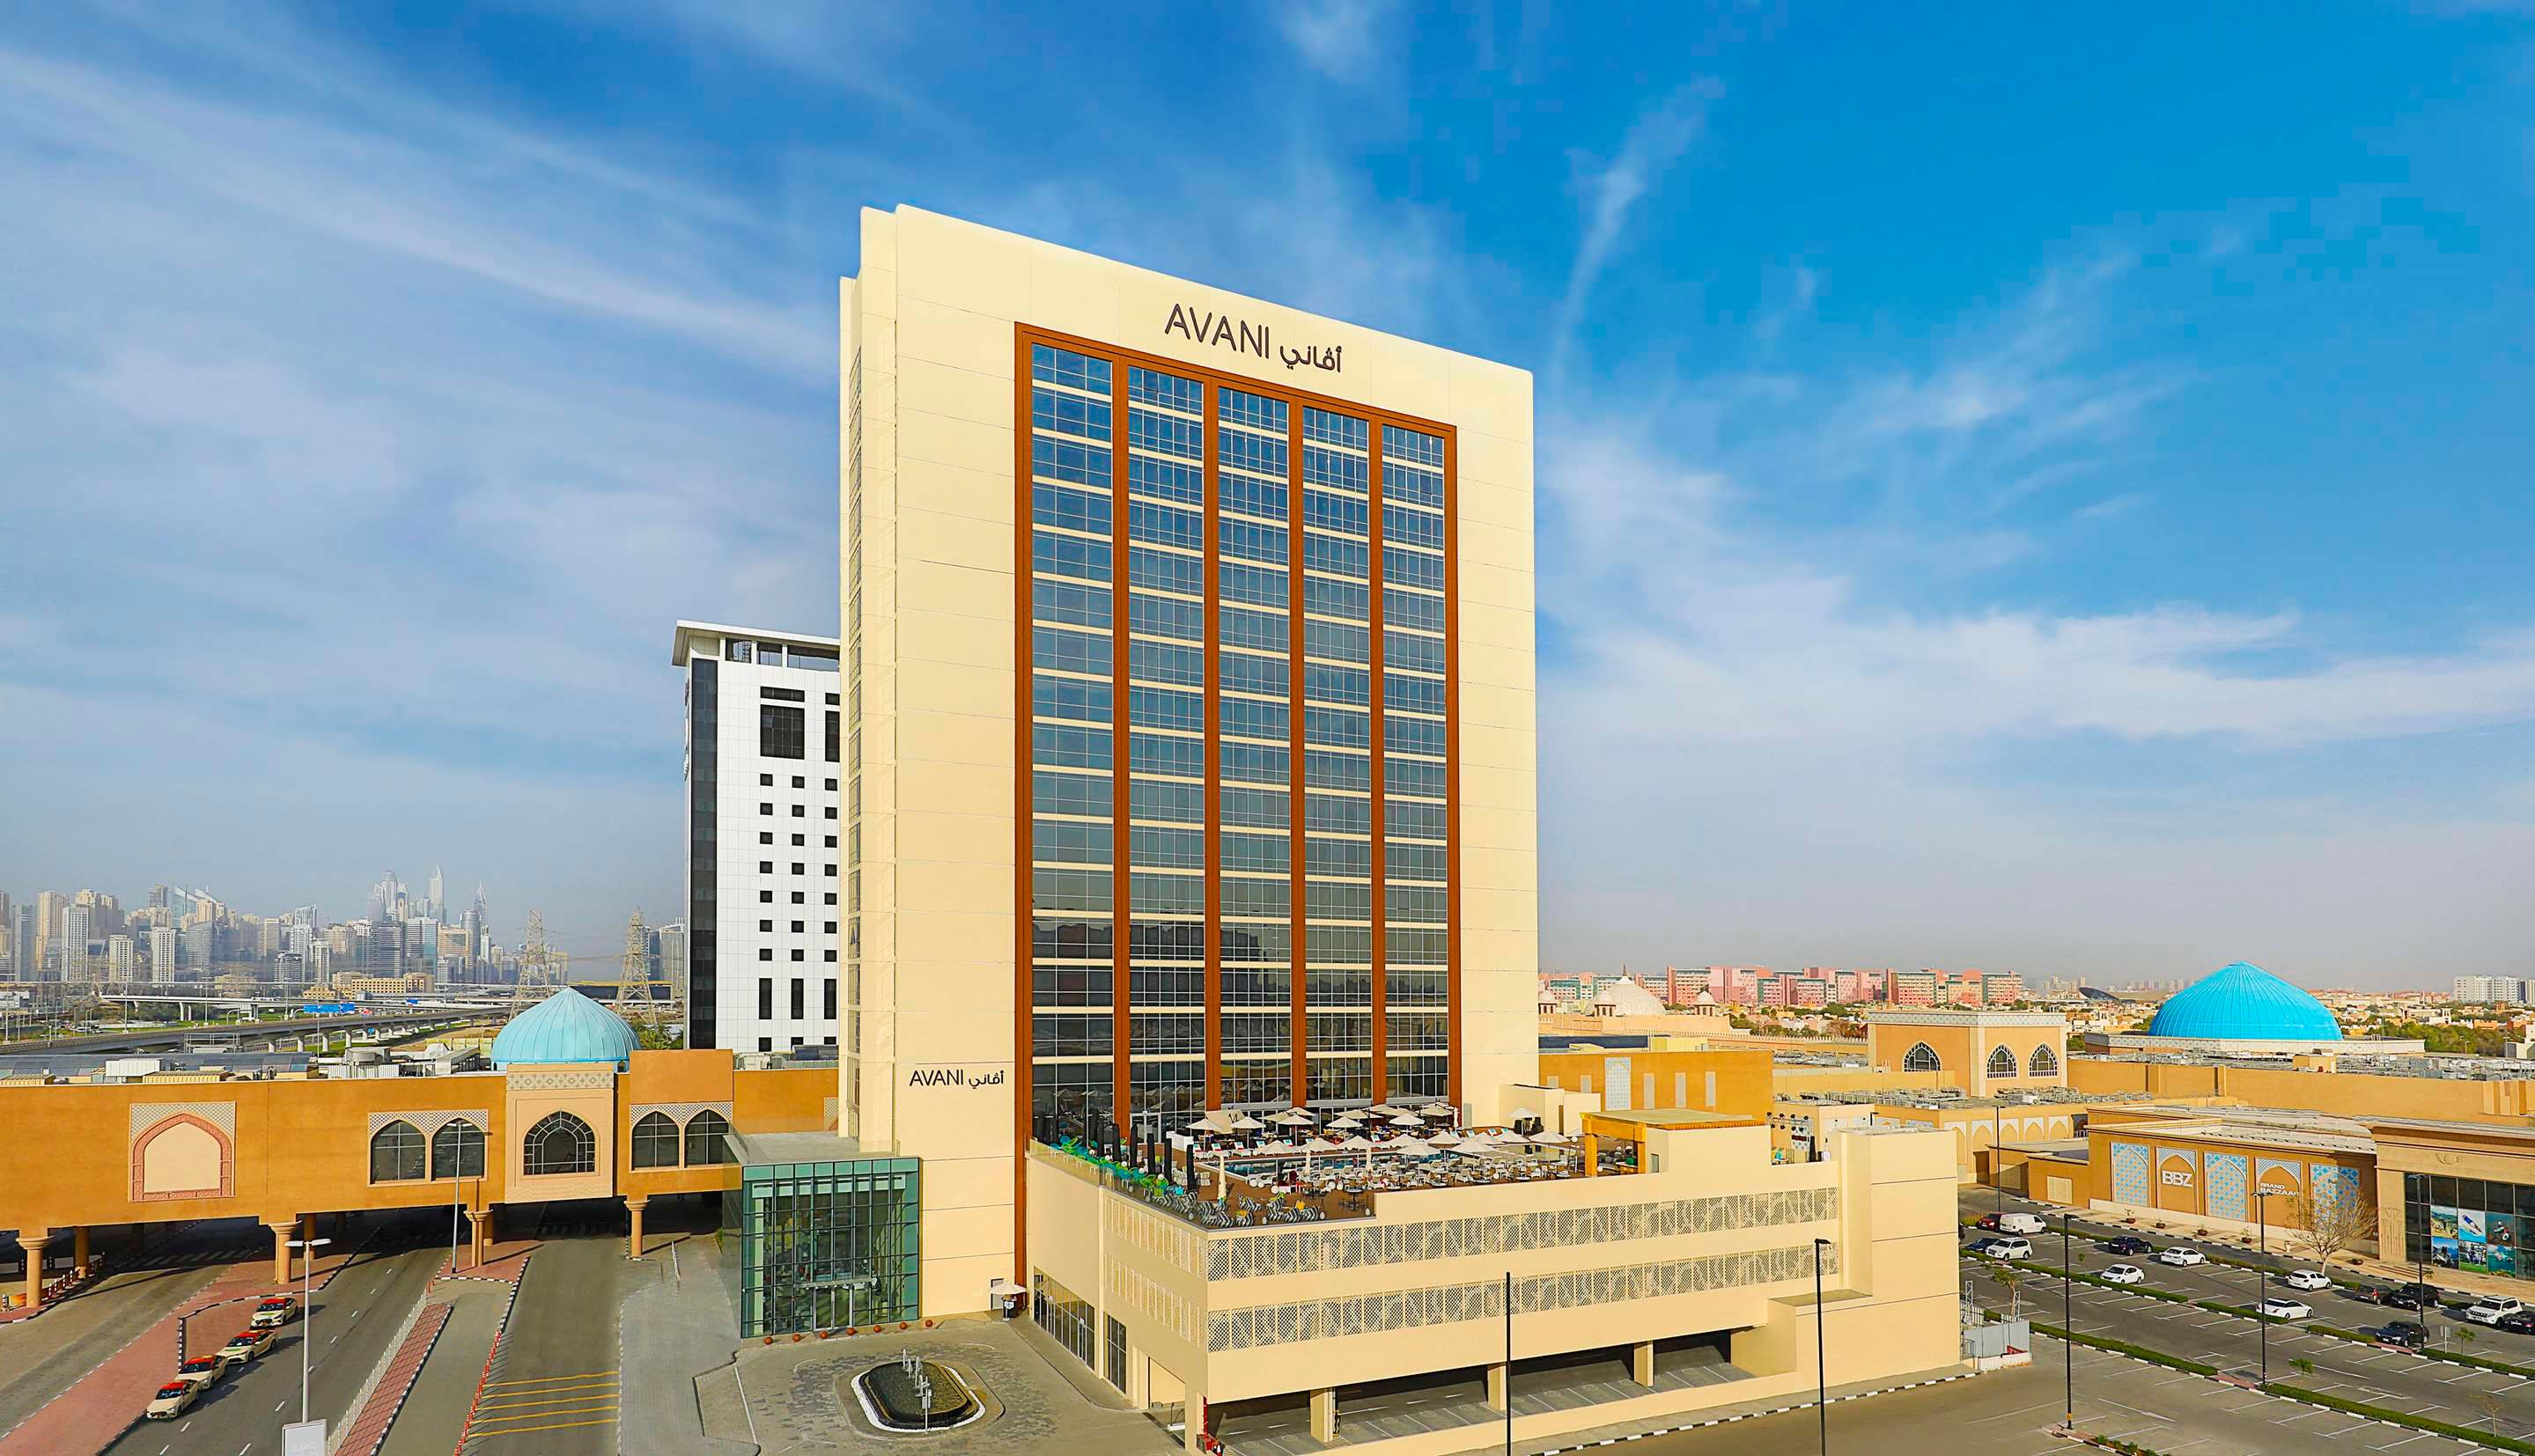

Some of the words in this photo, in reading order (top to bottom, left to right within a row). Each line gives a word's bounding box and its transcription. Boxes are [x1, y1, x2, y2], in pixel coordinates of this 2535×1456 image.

[1164, 303, 1269, 360] AVANI
[909, 1069, 963, 1087] AVANI
[2162, 1170, 2193, 1188] BBZ
